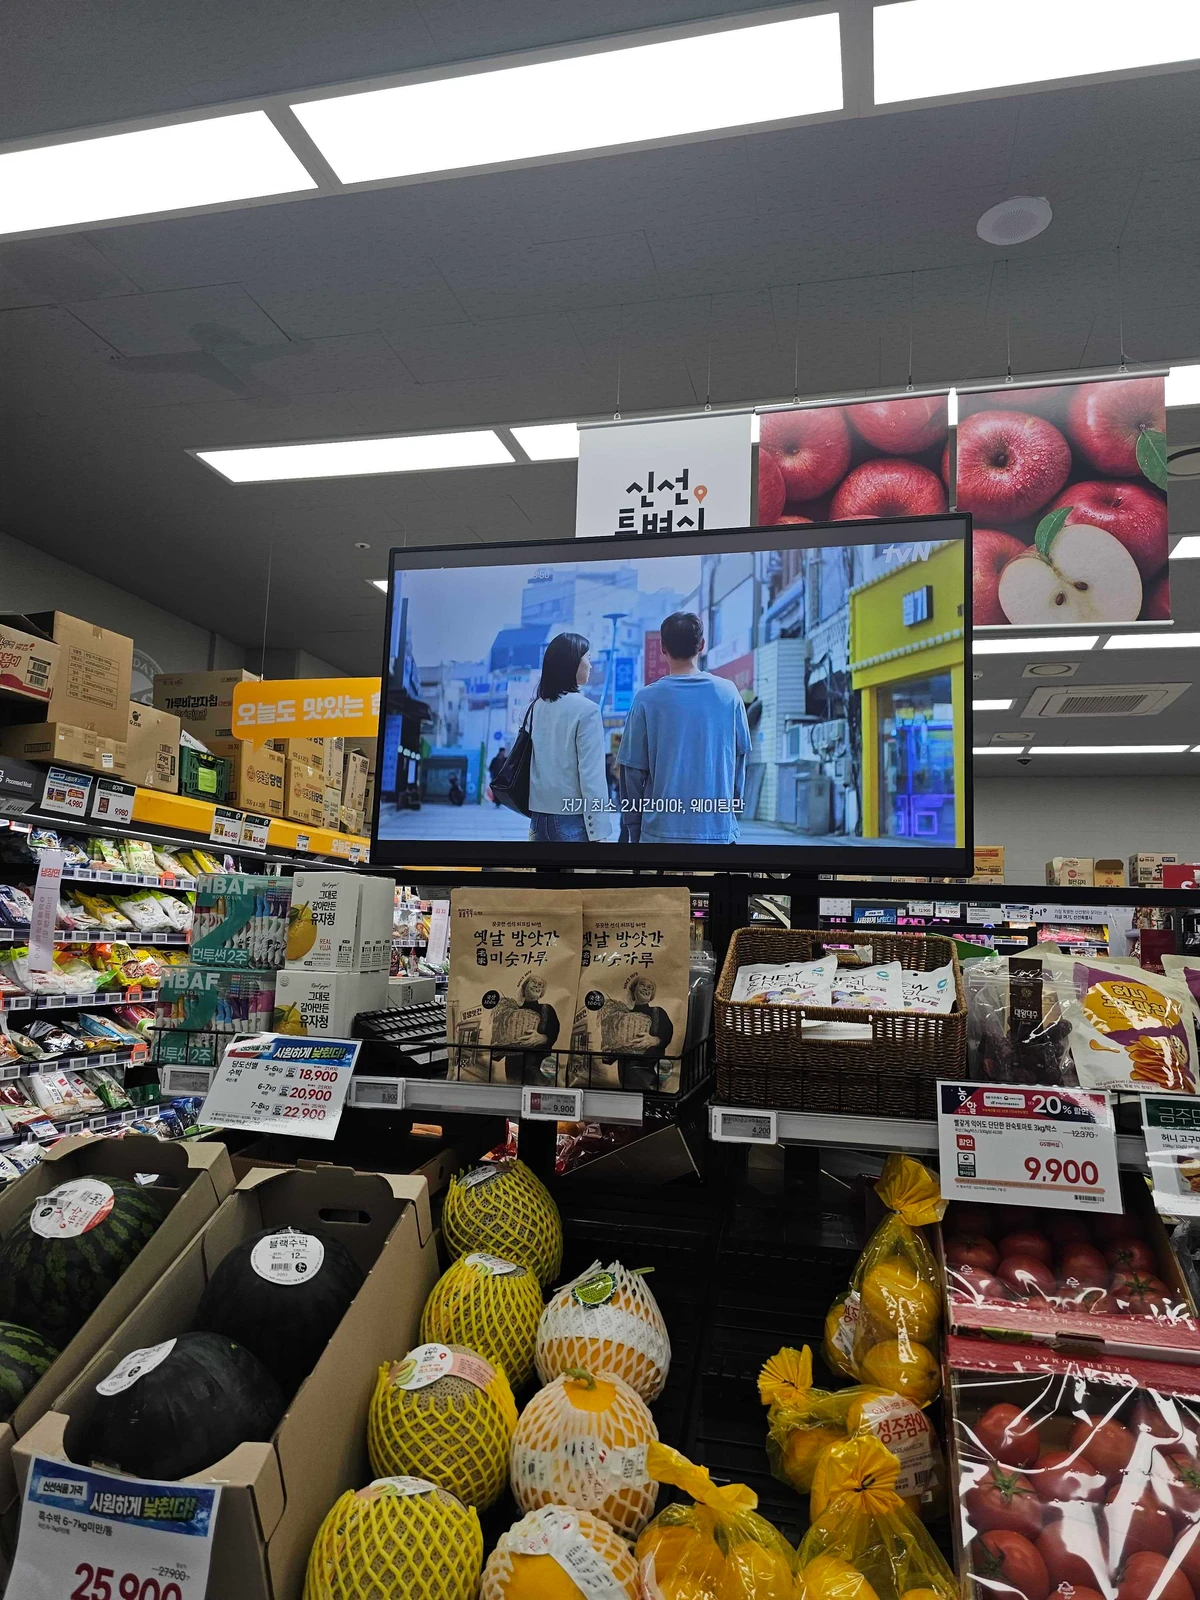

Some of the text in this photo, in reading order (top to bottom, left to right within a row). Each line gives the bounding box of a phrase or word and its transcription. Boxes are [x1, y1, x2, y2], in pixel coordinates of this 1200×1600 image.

[626, 468, 689, 508] 신선
[883, 543, 931, 564] tvN
[237, 700, 296, 726] 오늘도
[303, 695, 364, 721] 맛있는
[562, 797, 745, 814] 저기 최소 2시간이야, 웨이팅만
[198, 876, 255, 895] HBAF
[318, 890, 337, 899] 그대로
[312, 901, 336, 911] 갈아만든
[311, 913, 335, 926] 유자청
[474, 929, 560, 947] 옛날 방앗간
[616, 930, 664, 948] 방앗간
[490, 951, 548, 967] 미숫가루
[161, 972, 220, 990] HBAF
[308, 992, 330, 1001] 그대로
[1111, 985, 1147, 1001] 허니
[300, 1003, 329, 1014] 갈아만든
[1014, 1009, 1037, 1019] 대왕대추
[299, 1015, 328, 1029] 유자청
[273, 1046, 345, 1060] 시원하게 낮췄다!
[232, 1060, 259, 1069] 당도선별
[228, 1068, 242, 1077] 수박
[299, 1068, 338, 1082] 18,900
[289, 1087, 331, 1101] 20,900
[283, 1106, 325, 1120] 22,900
[954, 1119, 970, 1127] 빨갛게
[971, 1120, 987, 1128] 익어도
[988, 1121, 1005, 1129] 단단한
[1005, 1122, 1033, 1131] 완숙토마토
[958, 1138, 973, 1147] 할인
[1161, 1133, 1177, 1143] 허니
[1024, 1156, 1099, 1186] 9,900
[269, 1239, 308, 1248] 블랙수박
[1078, 1320, 1129, 1331] TOMATO
[1025, 1355, 1077, 1364] TOMATO
[877, 1411, 928, 1444] 성주참외
[42, 1480, 84, 1496] 신선식품 가격
[89, 1492, 197, 1520] 시원하게 낮췄다!
[38, 1510, 61, 1526] 흑수박
[71, 1562, 182, 1600] 25900
